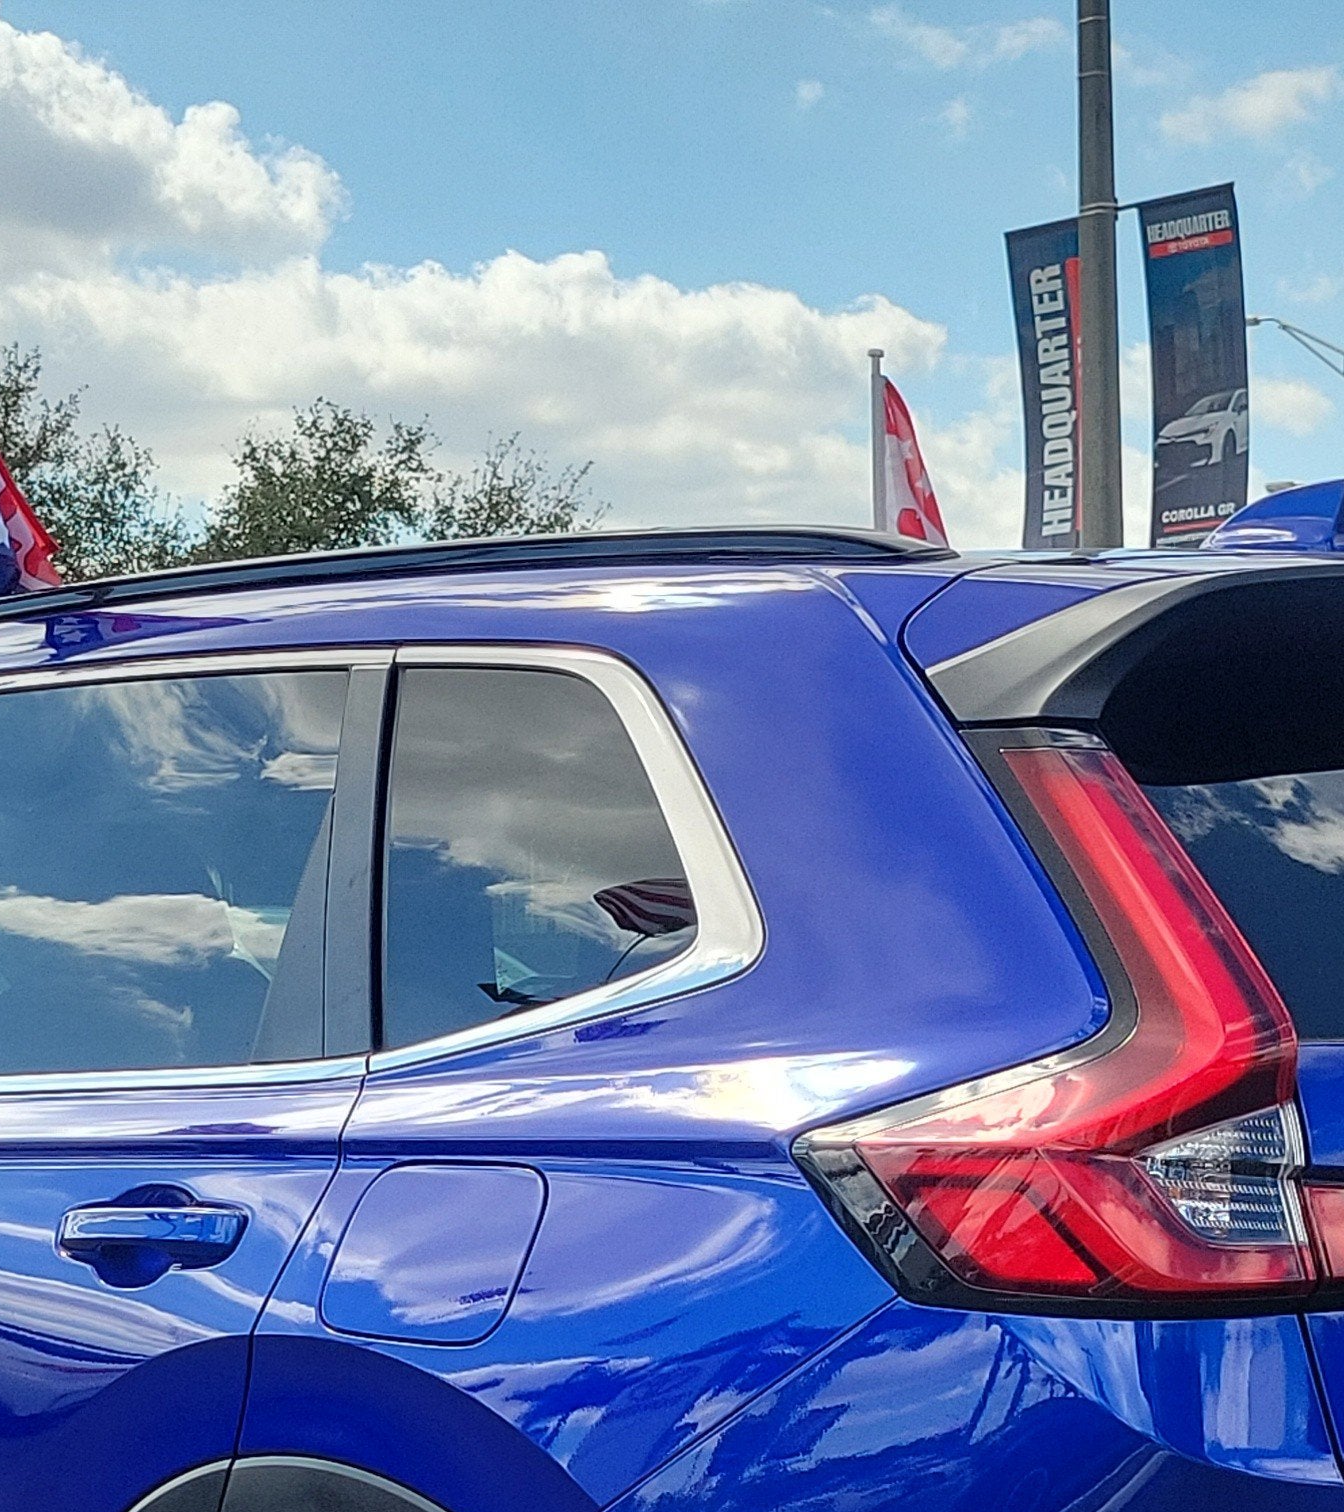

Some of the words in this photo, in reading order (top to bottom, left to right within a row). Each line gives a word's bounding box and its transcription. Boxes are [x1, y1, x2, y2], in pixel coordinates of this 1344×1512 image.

[1147, 209, 1231, 243] HEADQUARTER
[1029, 263, 1076, 537] HEADQUARTER
[1161, 505, 1215, 523] COROLLA
